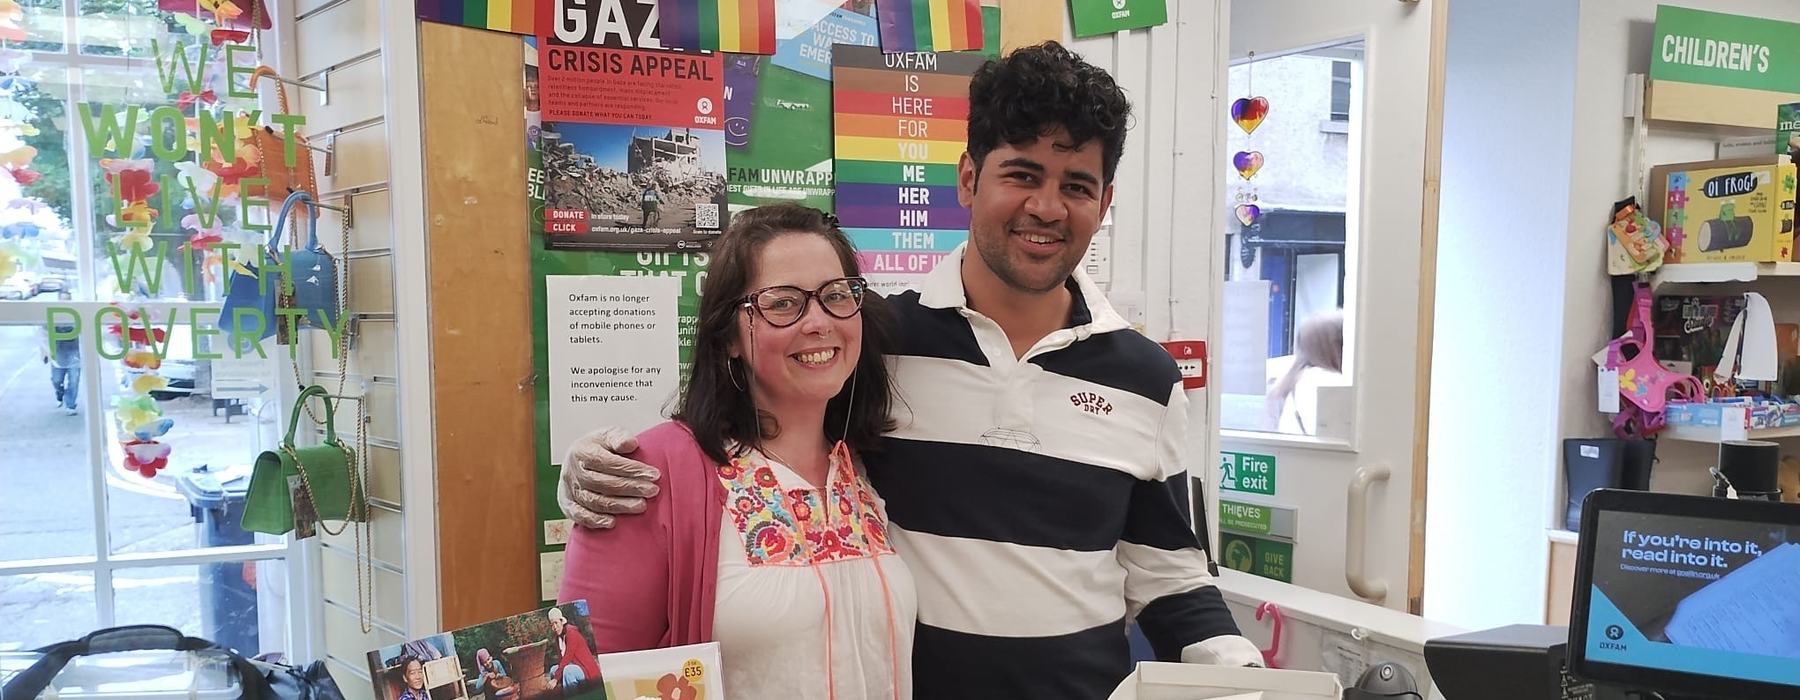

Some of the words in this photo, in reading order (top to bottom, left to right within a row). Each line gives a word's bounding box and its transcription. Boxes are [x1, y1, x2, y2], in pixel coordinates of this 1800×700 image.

[554, 0, 711, 54] GAZ
[861, 32, 874, 46] TO
[885, 52, 937, 71] OXFAM
[1662, 34, 1770, 73] CHILDREN'S
[151, 38, 258, 99] WE
[548, 50, 622, 74] CRISIS
[630, 54, 714, 82] APPEAL
[905, 75, 919, 92] IS
[892, 96, 933, 115] HERE
[694, 116, 717, 125] OXFAM
[898, 119, 928, 138] FOR
[77, 102, 306, 168] WON'T
[898, 142, 929, 160] YOU
[903, 165, 925, 182] ME
[1725, 174, 1755, 195] FROG!
[112, 174, 273, 231] LIVE
[898, 187, 930, 205] HER
[553, 211, 584, 219] DONATE
[613, 213, 630, 222] today
[900, 210, 928, 226] HIM
[553, 223, 576, 232] CLICK
[591, 226, 681, 235] oxfam.org.uk/gaza-crisis-appeal
[892, 232, 935, 249] THEM
[107, 241, 295, 297] WITH
[874, 254, 904, 271] ALL
[908, 254, 928, 271] OF
[569, 293, 598, 302] Oxfam
[600, 294, 607, 302] is
[622, 294, 650, 303] longer
[569, 308, 611, 317] accepting
[613, 307, 656, 316] donations
[46, 307, 353, 361] POVERTY
[581, 322, 611, 330] mobile
[613, 322, 645, 331] phones
[569, 336, 603, 344] tablets.
[588, 366, 629, 375] apologise
[631, 366, 644, 374] for
[646, 367, 661, 375] any
[571, 380, 633, 389] inconvenience
[635, 379, 653, 387] that
[571, 394, 587, 402] this
[590, 395, 608, 403] may
[1070, 392, 1113, 415] SUPER
[1084, 404, 1100, 415] DRY
[1242, 456, 1268, 473] Fire
[1242, 475, 1268, 490] exit
[1222, 503, 1261, 519] THIEVES
[1235, 520, 1267, 530] PROSECUTED
[1623, 530, 1637, 544] If
[1638, 532, 1701, 549] you're
[1704, 537, 1743, 553] into
[1744, 541, 1763, 557] it,
[1265, 552, 1284, 565] GIVE
[1621, 548, 1668, 562] read
[1670, 550, 1708, 566] into
[1711, 553, 1728, 568] it.
[1264, 564, 1285, 577] BACK
[1620, 563, 1649, 573] Discover
[1599, 641, 1627, 651] OXFAM
